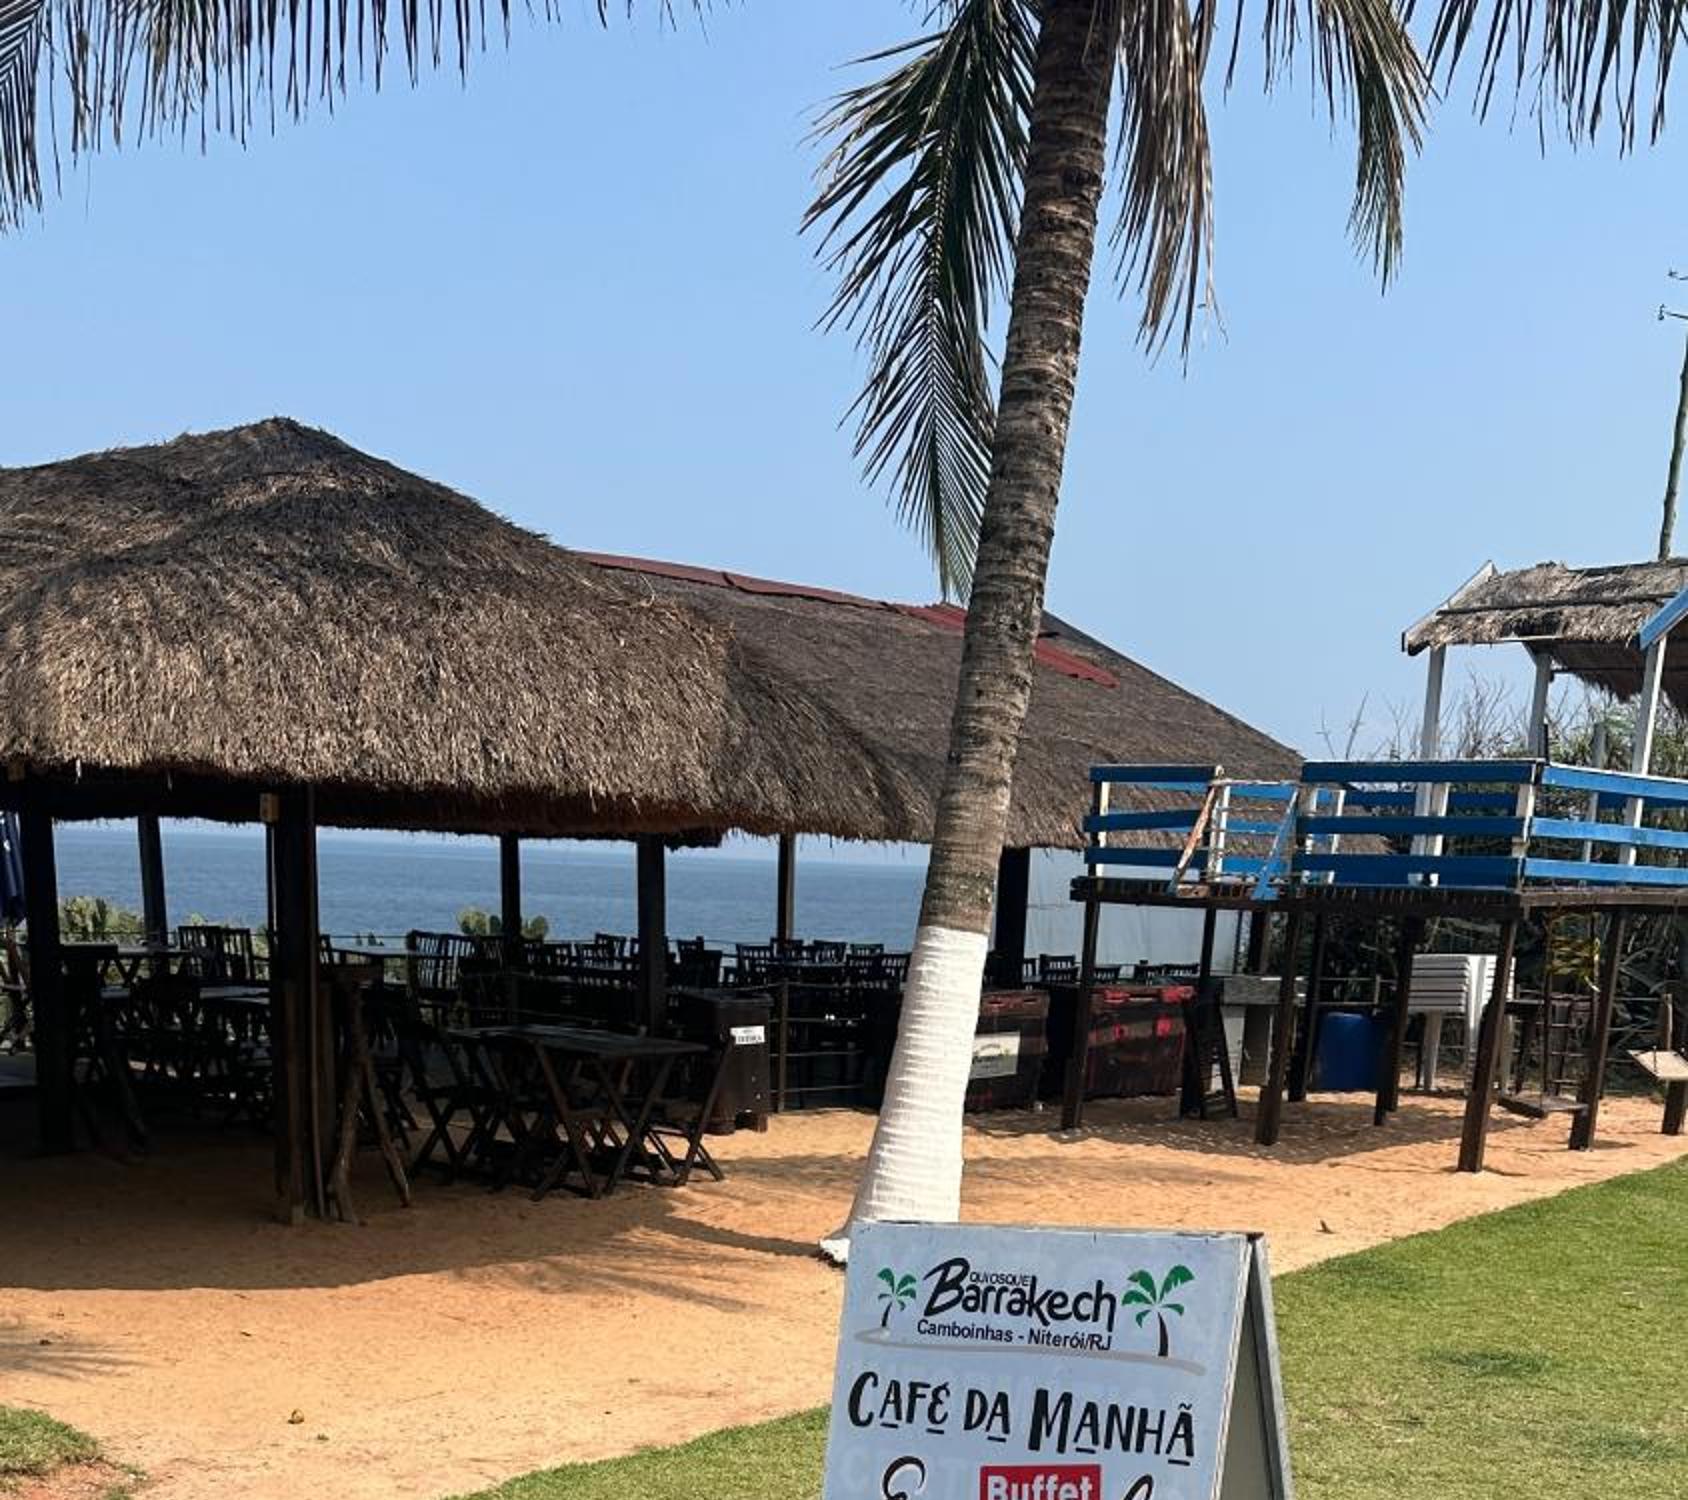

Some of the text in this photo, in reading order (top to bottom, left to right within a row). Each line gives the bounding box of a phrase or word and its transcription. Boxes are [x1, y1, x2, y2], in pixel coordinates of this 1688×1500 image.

[923, 1257, 1117, 1332] Barrakech
[968, 1271, 1031, 1286] QUIOSQUE
[917, 1319, 1013, 1342] Camboinhas
[1028, 1328, 1112, 1351] Niterói/RJ
[848, 1371, 1195, 1466] CAFÉ DA MANHÃ
